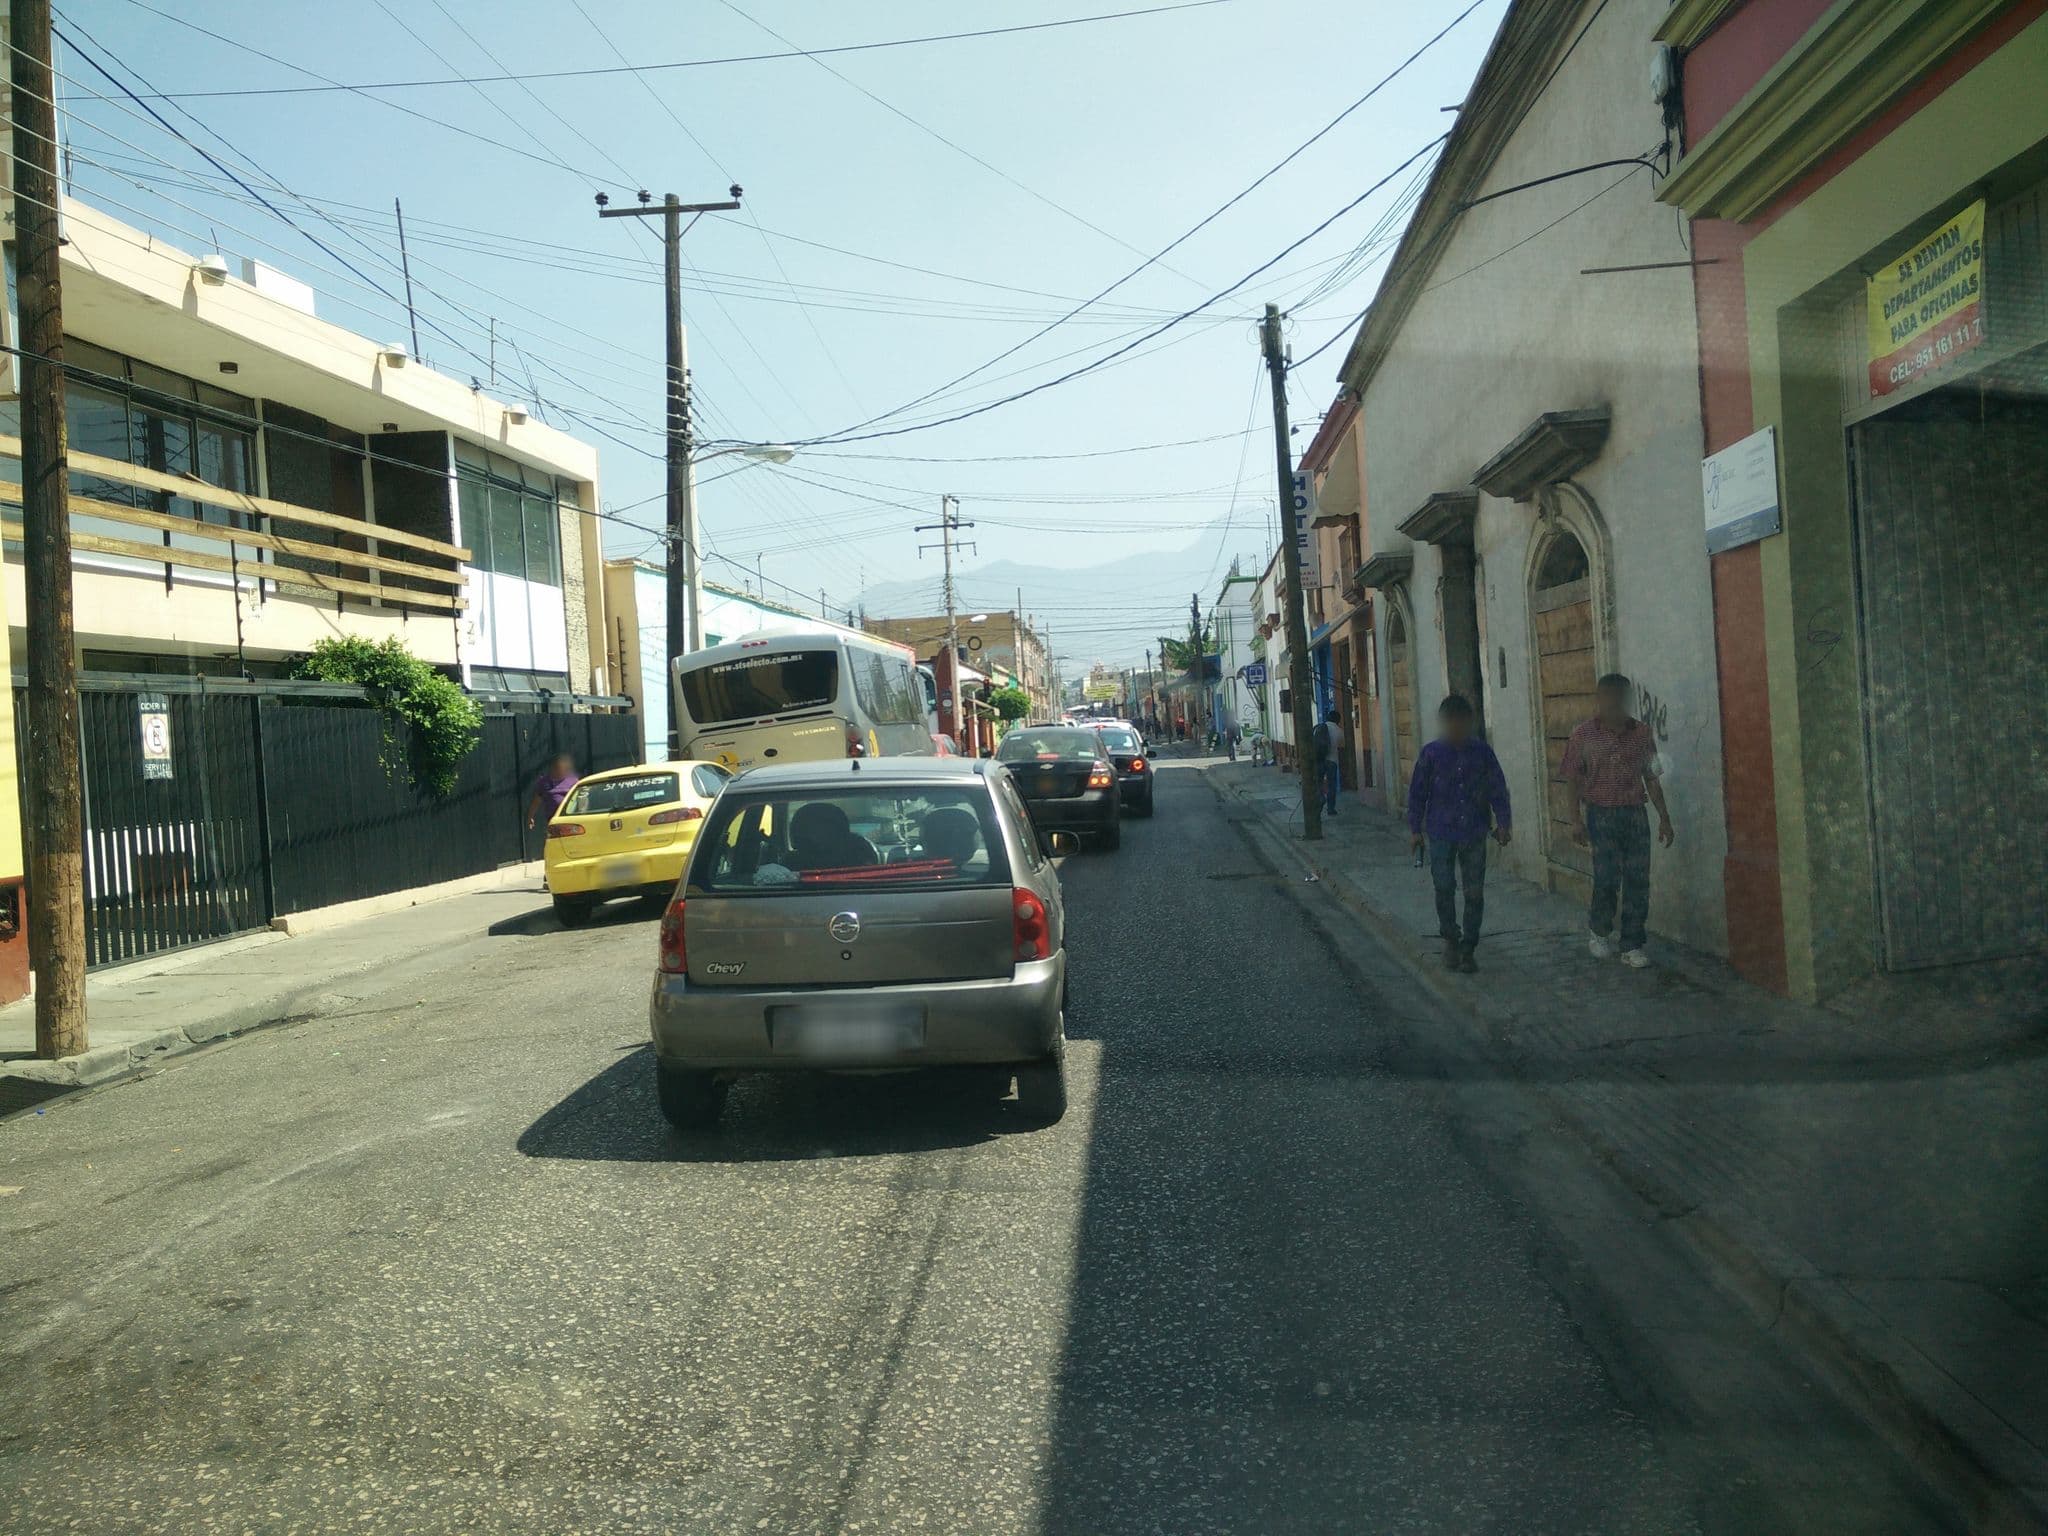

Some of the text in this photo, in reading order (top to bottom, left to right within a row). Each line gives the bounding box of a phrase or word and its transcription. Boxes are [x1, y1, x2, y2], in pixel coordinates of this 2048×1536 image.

[1883, 239, 1981, 321] DEPARTAMENTOS
[1898, 224, 1961, 283] SE RENTAN
[1891, 273, 1979, 344] PARA OFICINAS
[1935, 331, 1955, 357] 161
[1292, 476, 1309, 567] HOTEL
[712, 654, 804, 674] www.stselecto.com.mx
[706, 962, 745, 977] Chevy
